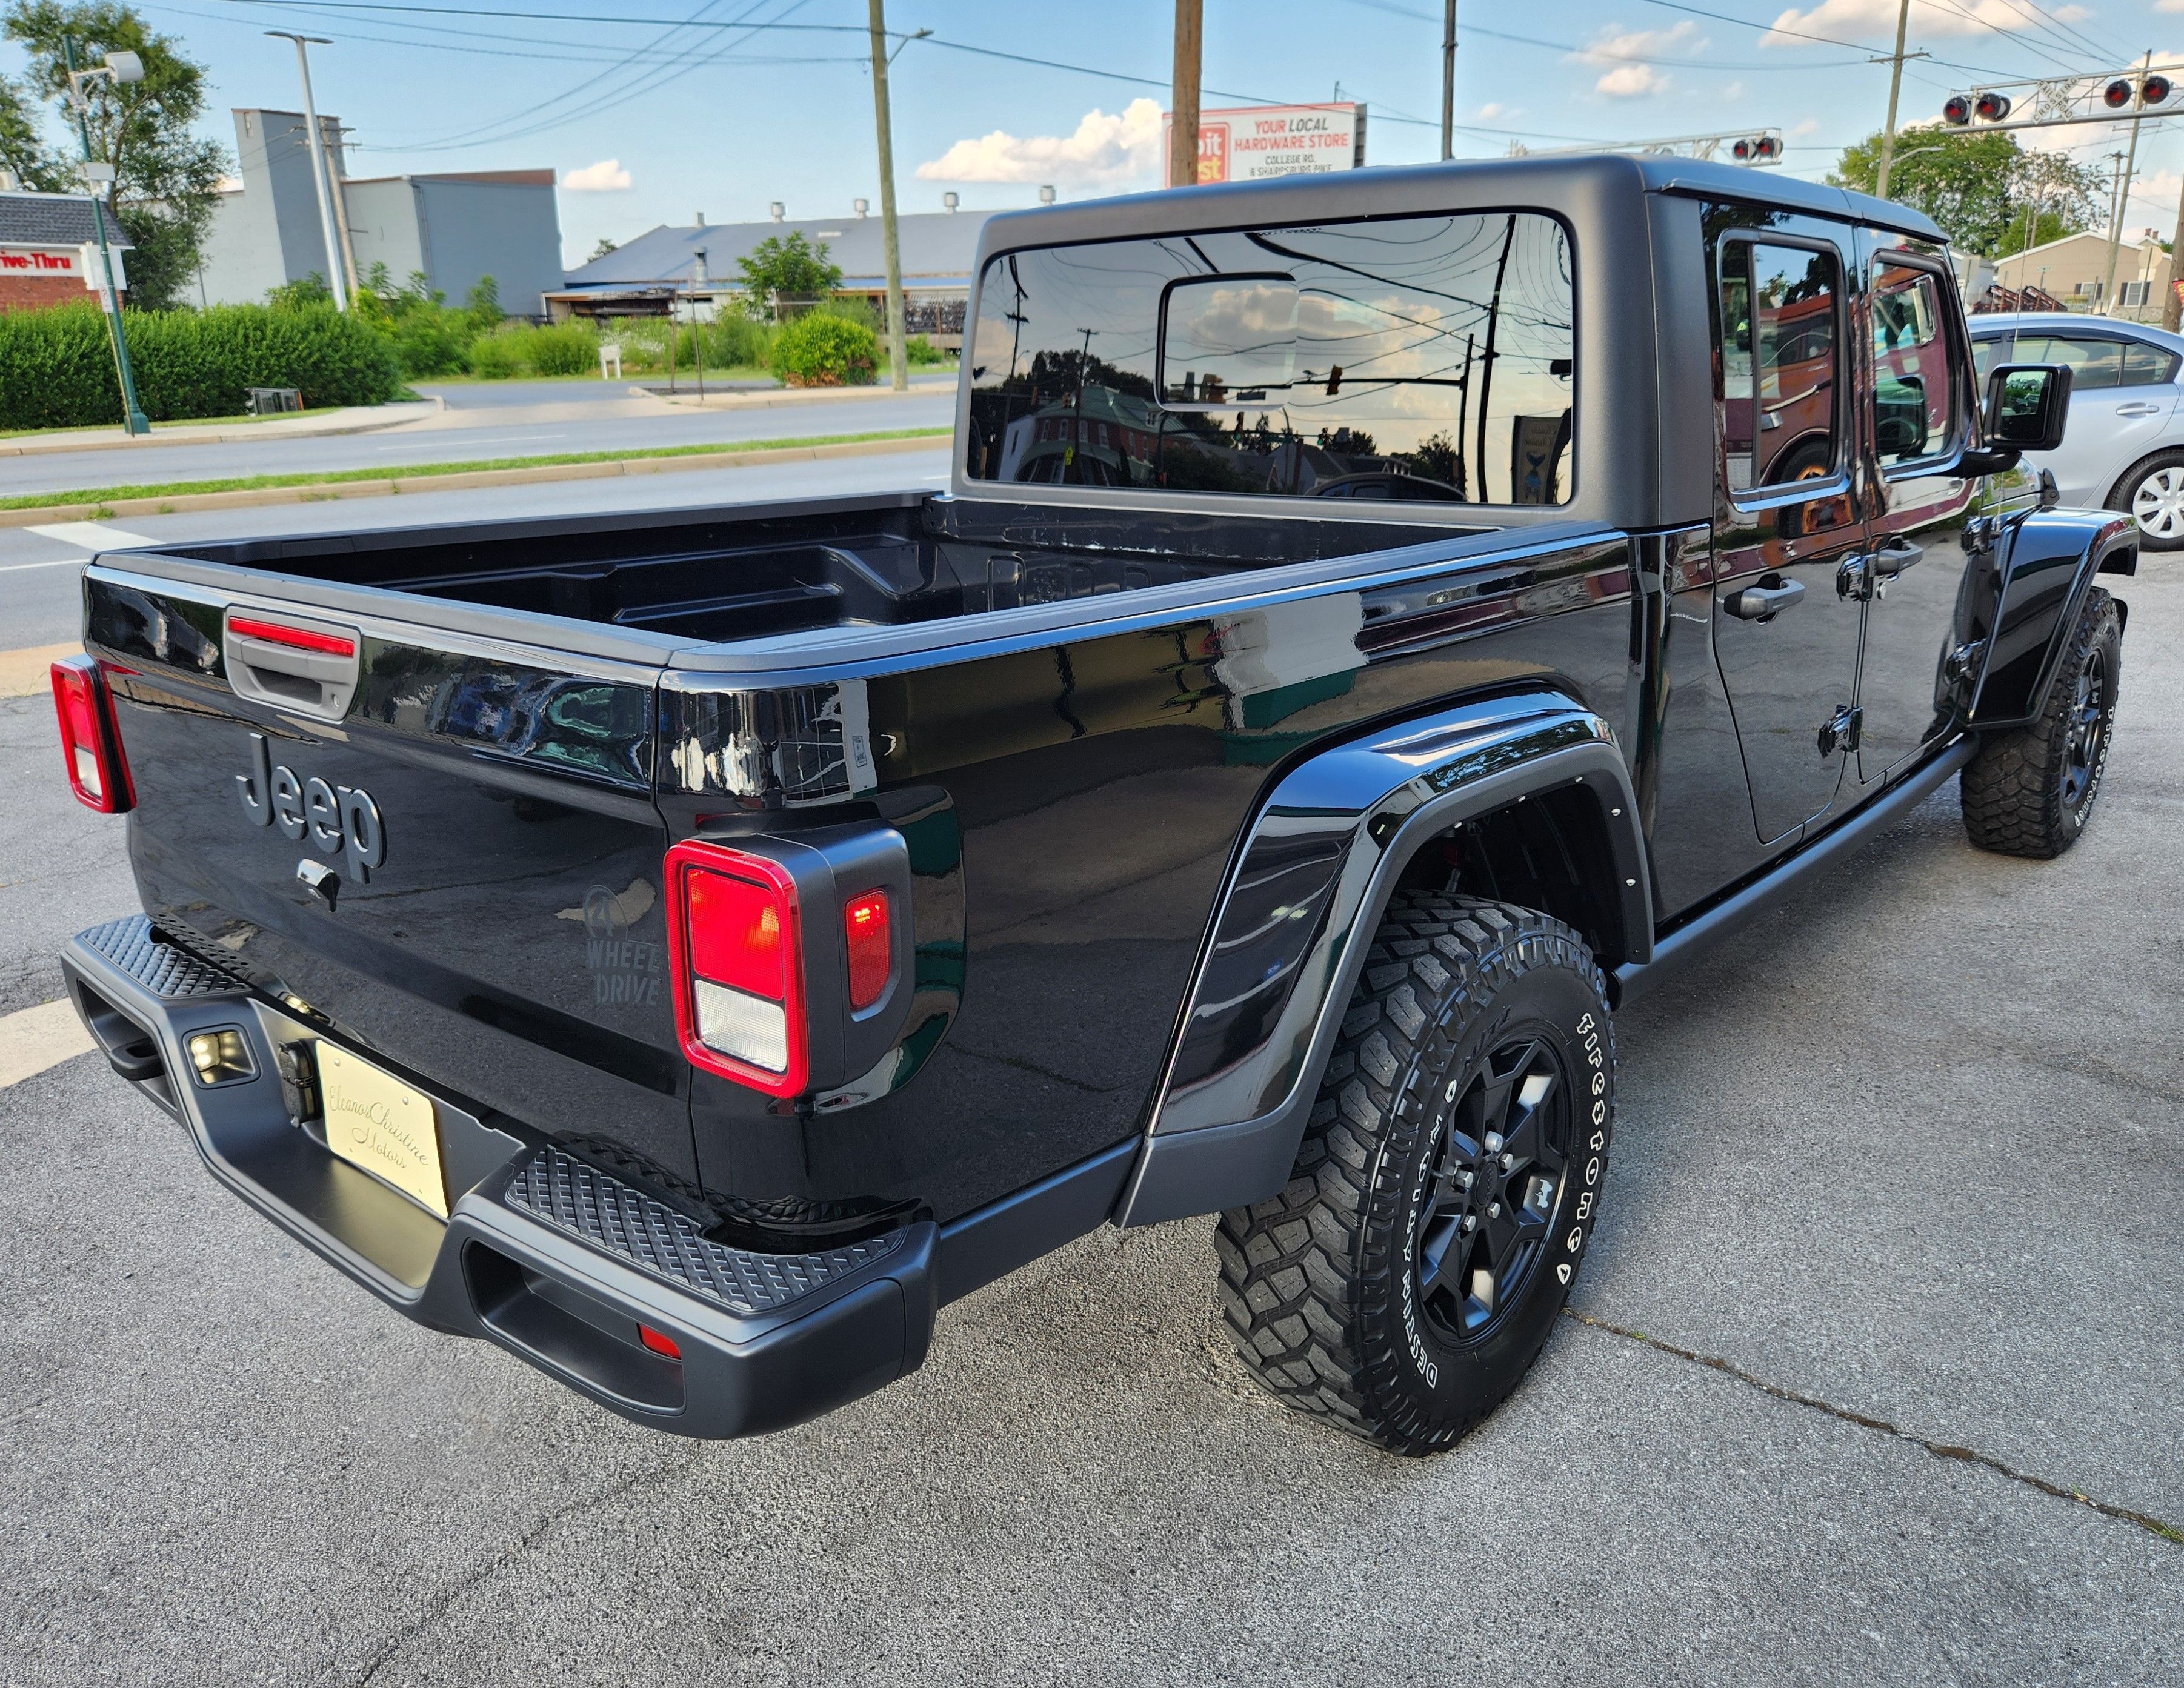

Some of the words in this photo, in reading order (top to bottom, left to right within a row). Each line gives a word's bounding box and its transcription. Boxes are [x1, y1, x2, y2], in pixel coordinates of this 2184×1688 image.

[1234, 136, 1305, 151] HARDWARE
[1308, 133, 1348, 148] STORE
[1255, 119, 1286, 134] YOUR
[1288, 117, 1328, 132] LOCAL
[236, 732, 387, 884] Jeep
[593, 897, 614, 937] 4
[586, 940, 660, 973] WHEEL
[596, 973, 661, 1005] DRIVE
[351, 1126, 407, 1169] Motors
